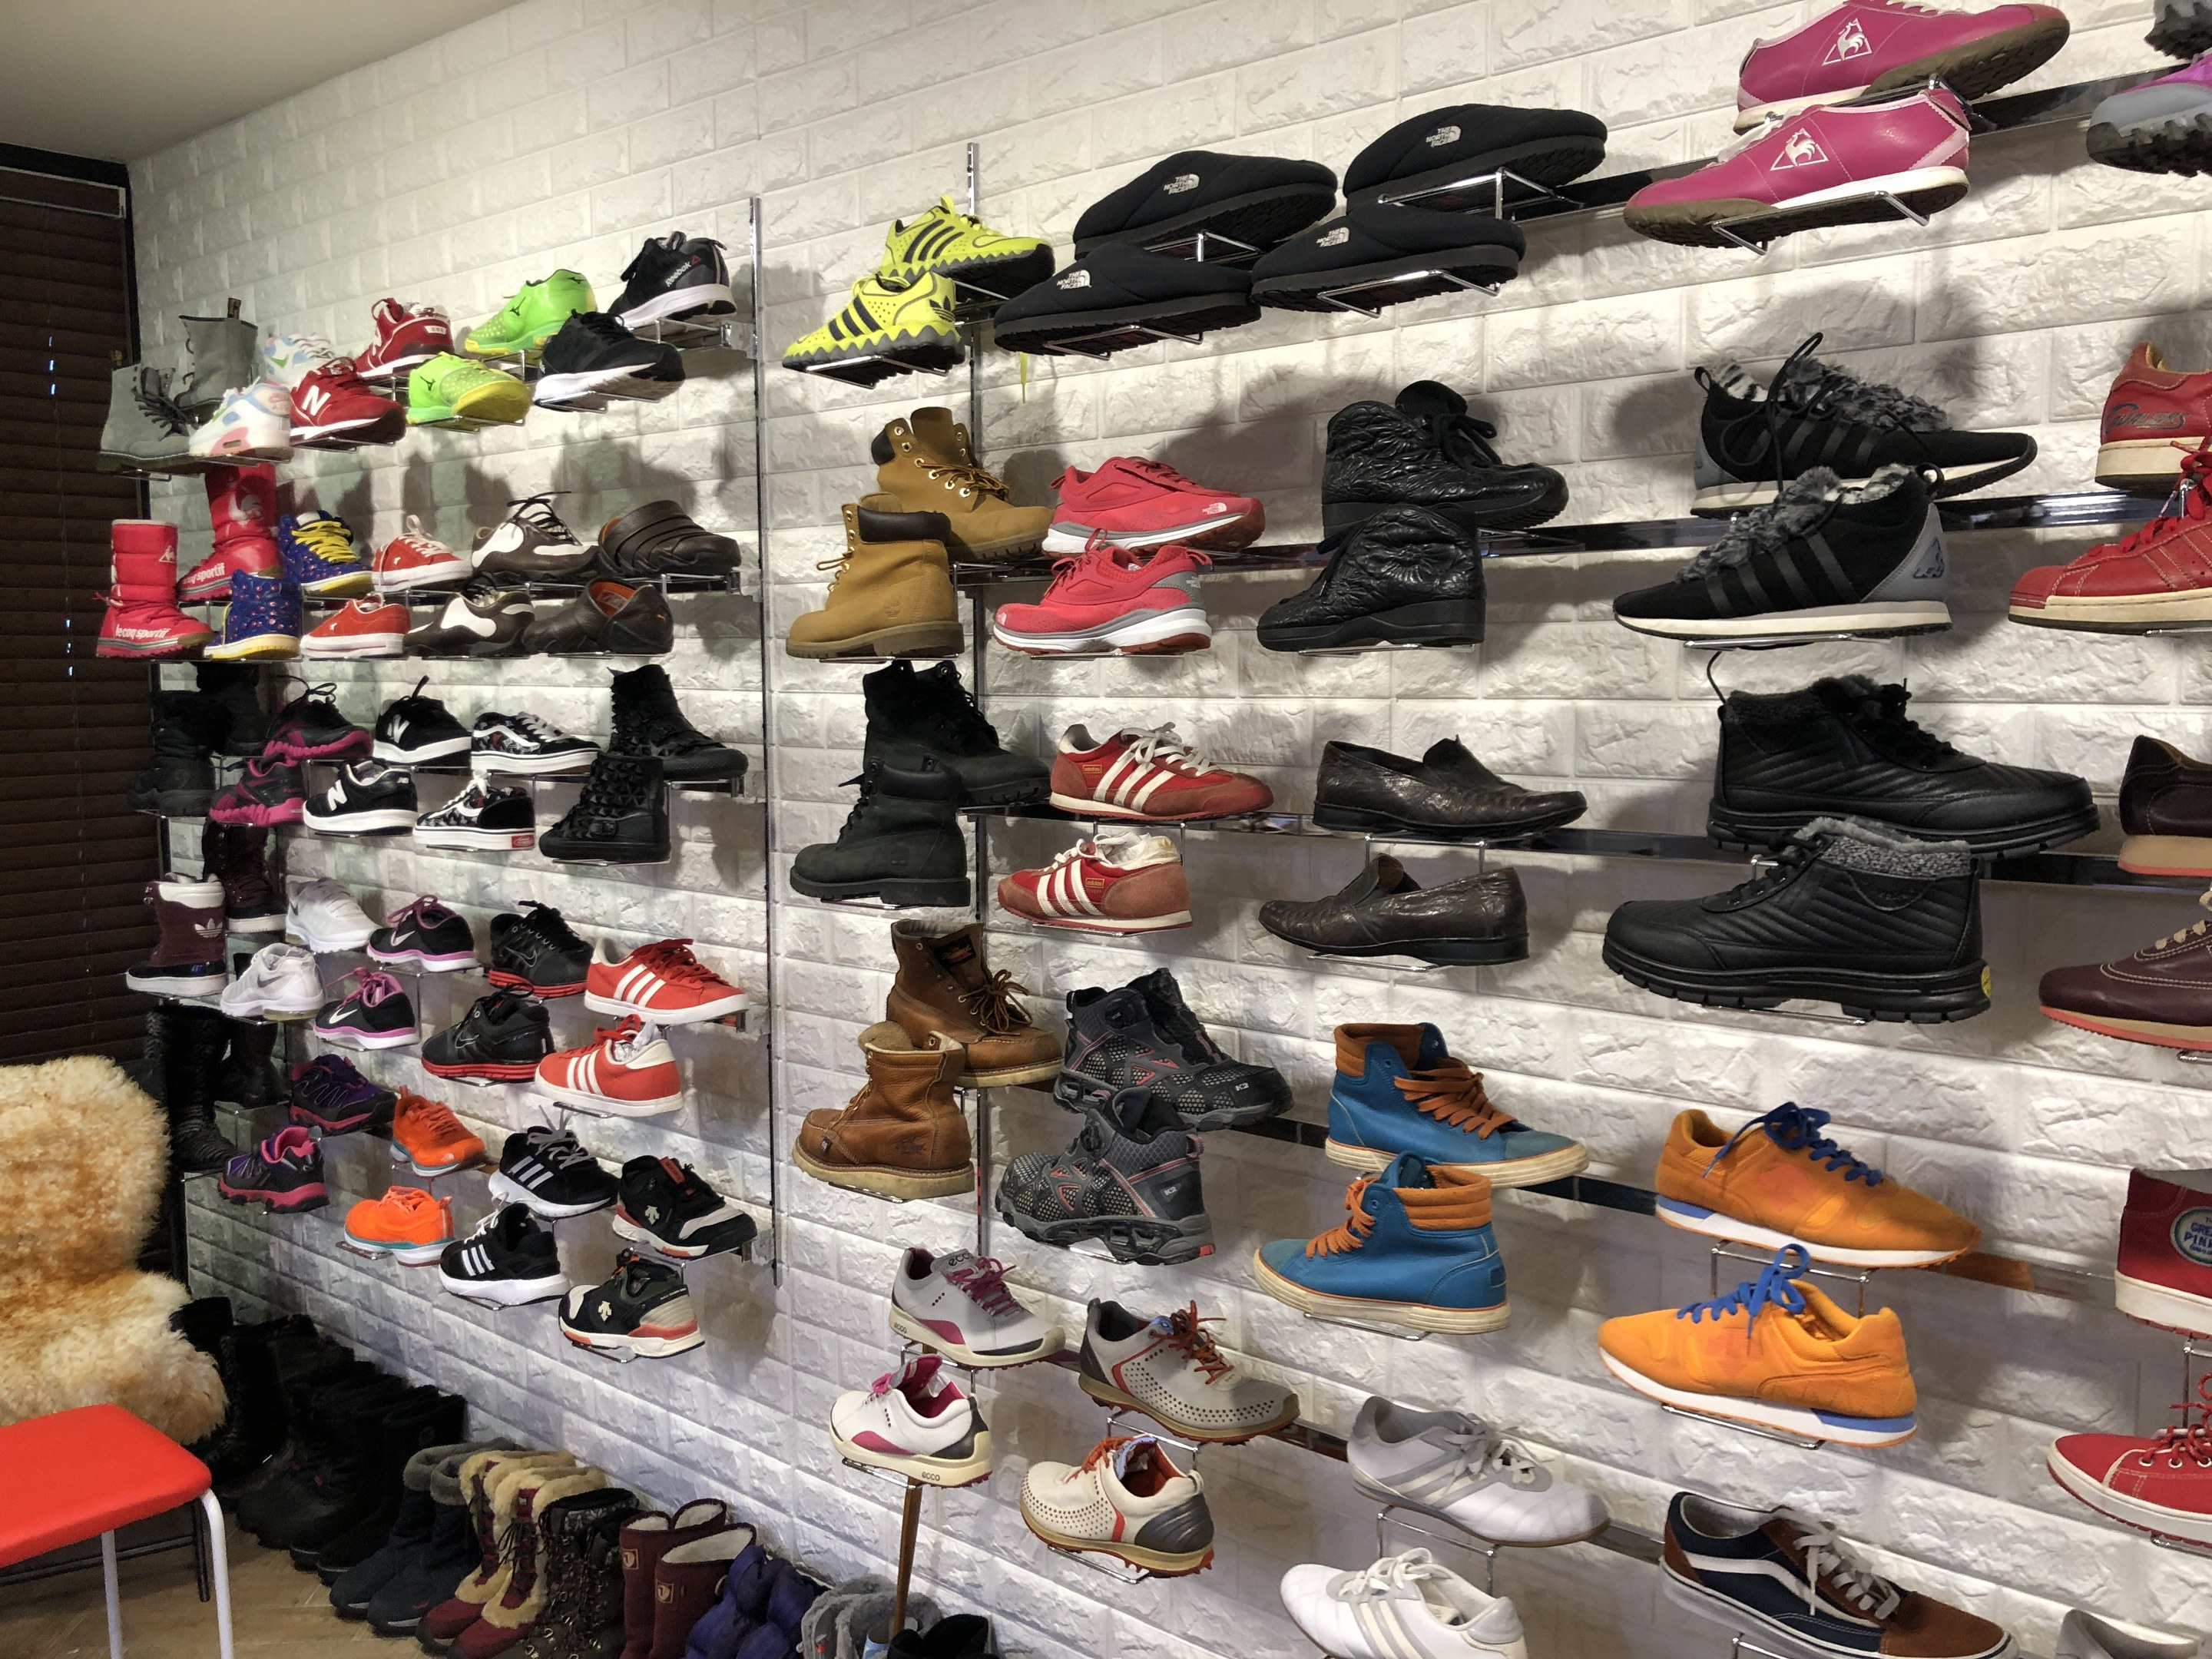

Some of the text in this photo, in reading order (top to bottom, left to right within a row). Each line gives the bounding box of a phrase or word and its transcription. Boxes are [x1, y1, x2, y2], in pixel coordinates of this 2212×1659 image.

[665, 261, 691, 287] Reebok
[302, 385, 331, 416] N
[135, 628, 171, 640] sportif
[327, 780, 348, 811] N
[922, 1471, 941, 1482] ecco
